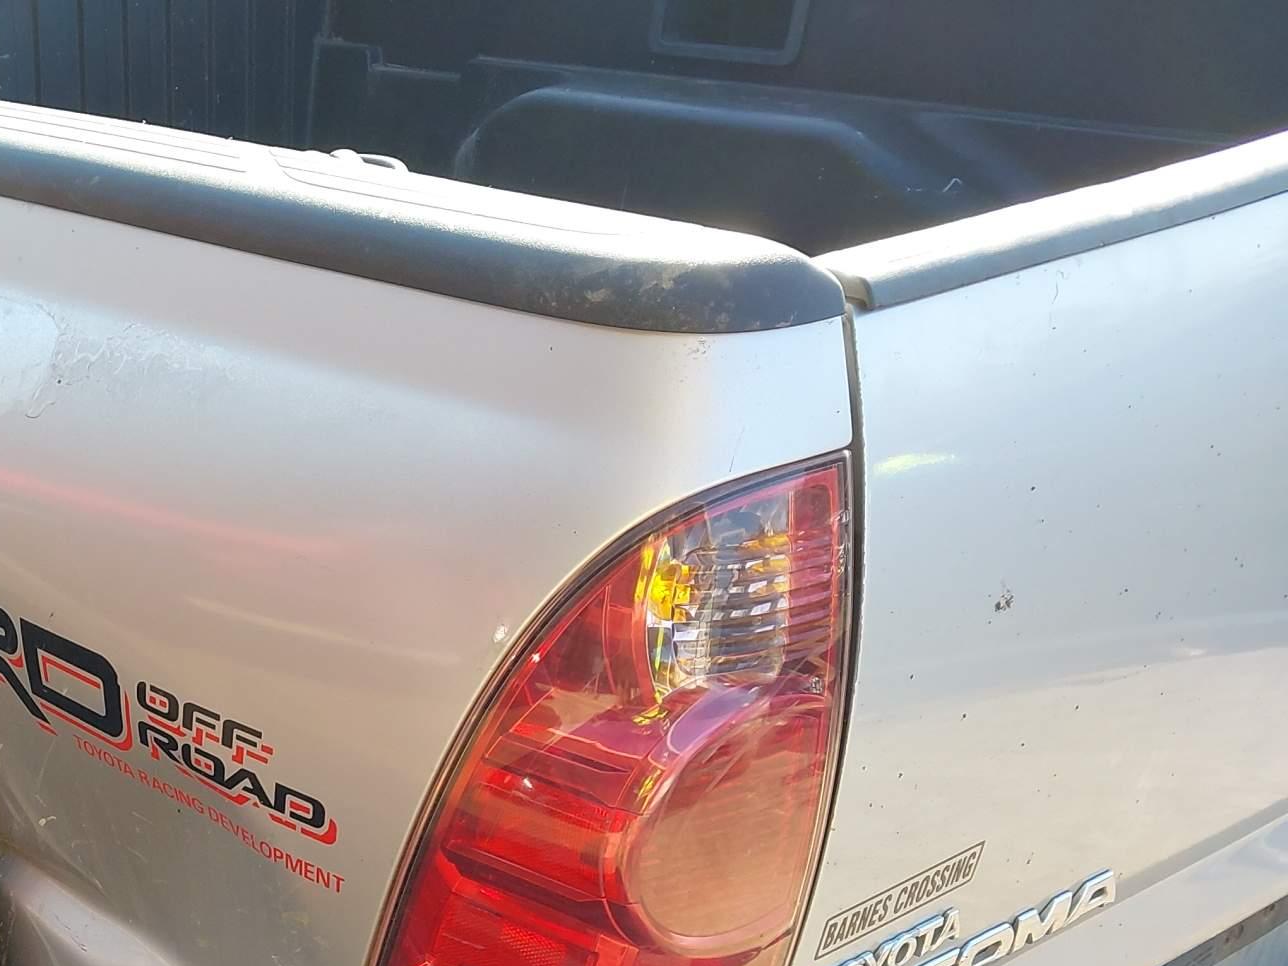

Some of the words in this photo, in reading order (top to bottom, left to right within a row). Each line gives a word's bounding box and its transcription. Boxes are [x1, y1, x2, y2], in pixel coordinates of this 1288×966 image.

[136, 681, 274, 766] OFF
[72, 734, 135, 780] TOYOTA
[138, 765, 205, 815] RACING
[208, 800, 346, 894] DEVELOPMENT
[137, 721, 339, 846] ROAD
[822, 896, 891, 949] BARNES
[893, 850, 978, 915] CROSSING
